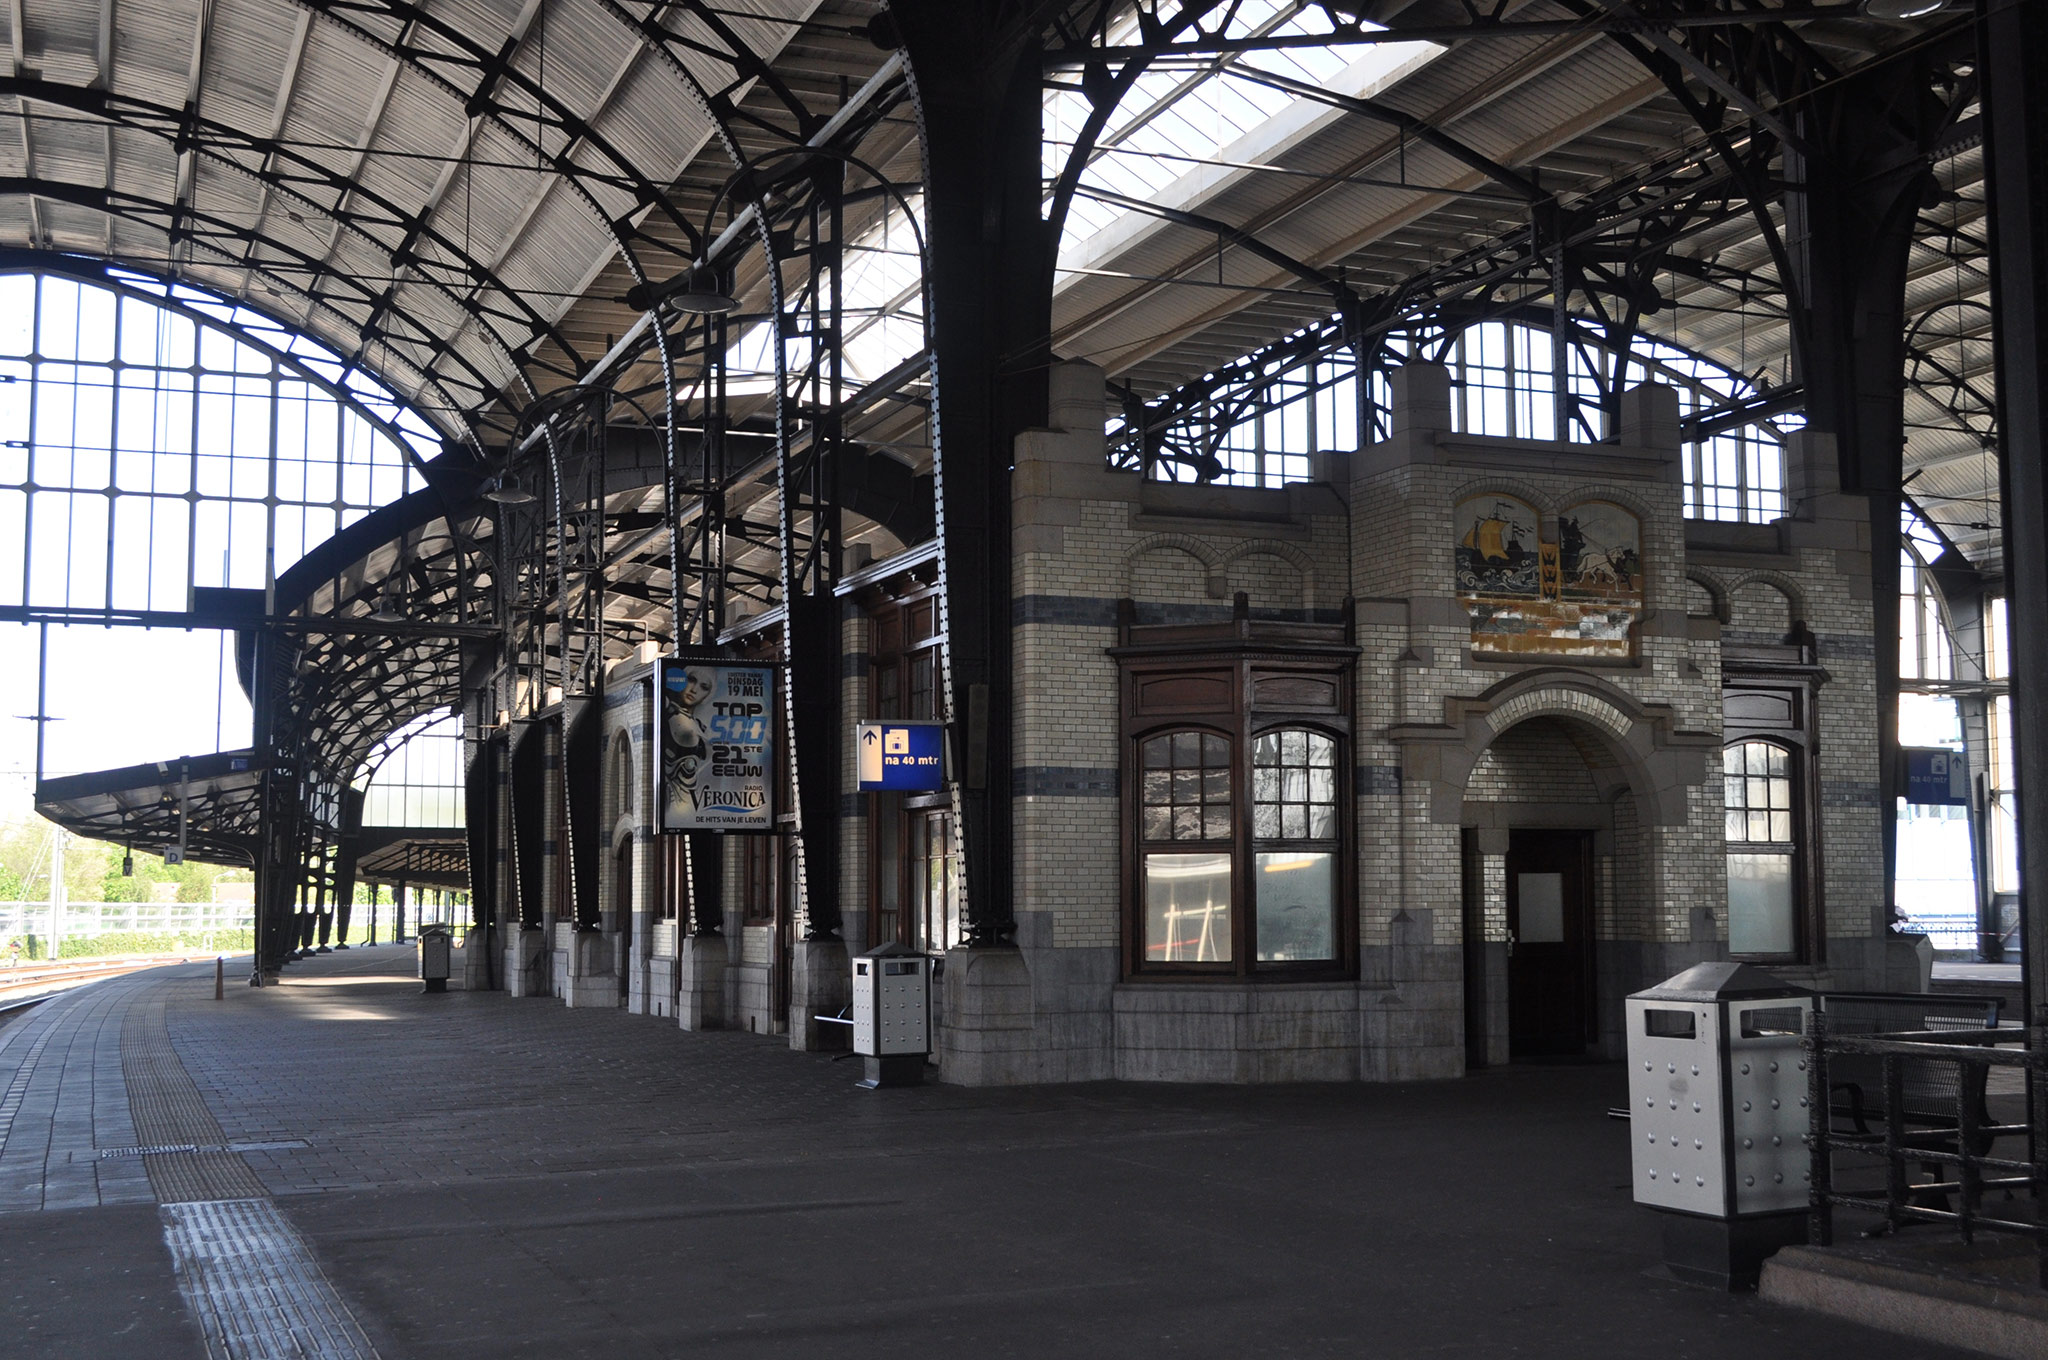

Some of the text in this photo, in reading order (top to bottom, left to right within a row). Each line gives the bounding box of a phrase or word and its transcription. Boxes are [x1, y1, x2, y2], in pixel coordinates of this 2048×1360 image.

[728, 677, 763, 686] DINSDAG
[728, 686, 763, 697] 19 MEI
[713, 702, 763, 718] TOP
[709, 715, 767, 744] 500
[885, 755, 939, 765] na 40 mtr
[712, 764, 763, 777] EEUW
[1910, 775, 1948, 783] na 40 mtr
[688, 785, 766, 812] VERONICA
[737, 816, 744, 824] JE
[169, 852, 178, 863] D
